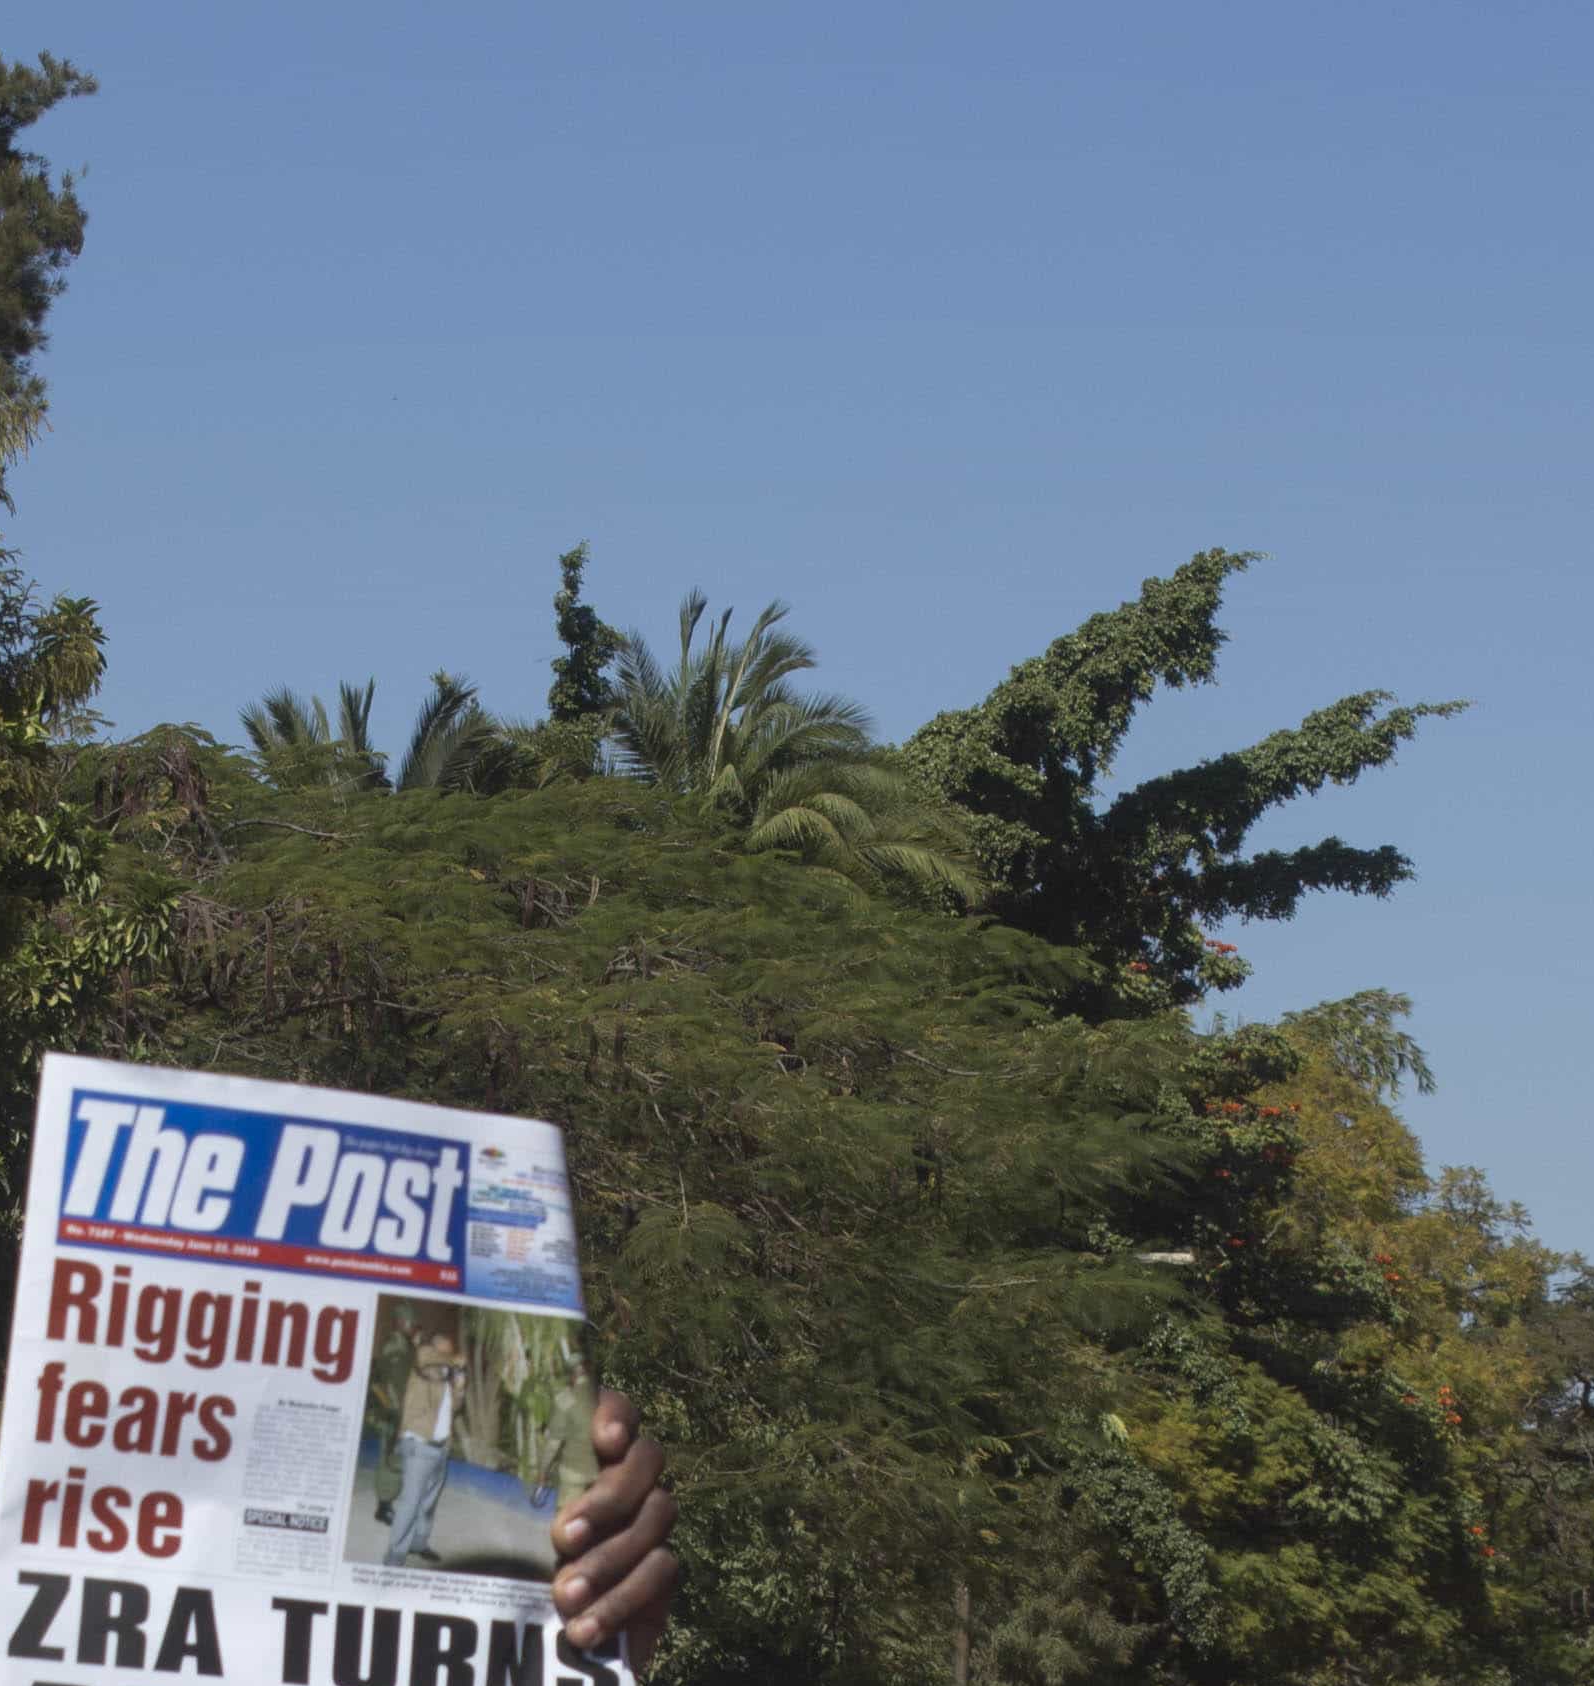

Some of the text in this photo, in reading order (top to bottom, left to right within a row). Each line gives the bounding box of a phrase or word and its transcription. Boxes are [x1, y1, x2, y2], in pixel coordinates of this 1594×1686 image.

[63, 1097, 464, 1263] The Post
[46, 1257, 359, 1384] Rigging
[35, 1361, 237, 1463] fears
[21, 1467, 184, 1559] rise
[6, 1570, 224, 1678] ZRA
